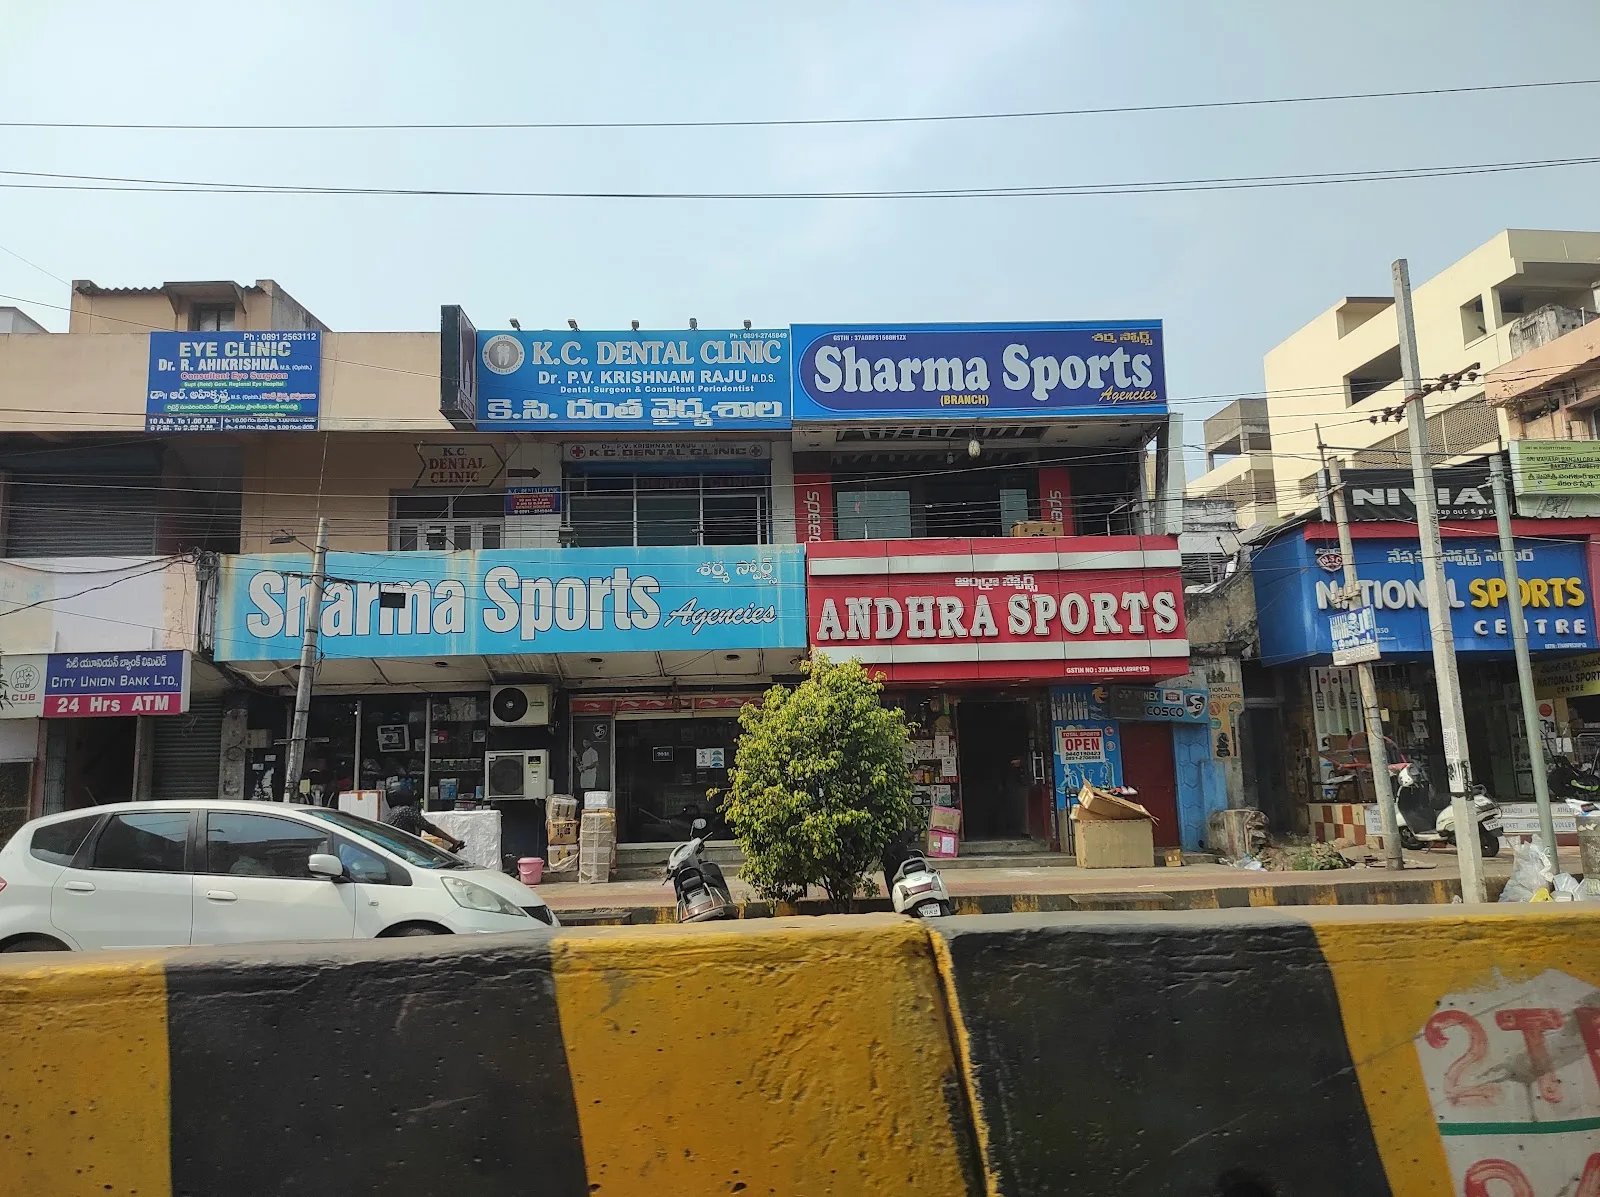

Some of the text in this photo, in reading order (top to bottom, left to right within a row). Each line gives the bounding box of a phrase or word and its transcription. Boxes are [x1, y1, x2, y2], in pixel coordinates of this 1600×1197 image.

[179, 341, 291, 357] EYE CLINIC
[532, 340, 782, 365] K.C. DENTAL CLINIC
[158, 358, 176, 371] Dr.
[181, 359, 194, 371] R.
[198, 358, 279, 371] AHIKRISHNA
[181, 371, 289, 381] Consultant Eye Surgeon
[538, 370, 776, 385] Dr. P.V. KRISHNAM RAJU M.D.S.
[813, 342, 1153, 402] Sharma Sports
[560, 386, 591, 394] Dental
[593, 386, 631, 394] Surgeon
[644, 385, 695, 393] Consultant
[940, 385, 1158, 407] (BRANCH) Agencies
[622, 448, 687, 457] DENTAL
[689, 448, 747, 456] CLINIC
[429, 457, 486, 470] DENTAL
[430, 470, 480, 484] CLINIC
[1434, 508, 1451, 517] tep
[1321, 554, 1343, 566] NSC
[1315, 578, 1465, 610] NTIONL
[246, 566, 777, 641] Sharma Sports Agencies
[817, 591, 1179, 640] ANDHRA SPORTS
[1473, 618, 1587, 635] CETRE
[11, 693, 36, 702] CUB
[57, 695, 170, 713] 24 Hrs ATM
[1146, 706, 1184, 718] COSCO
[1065, 738, 1099, 751] OPEN
